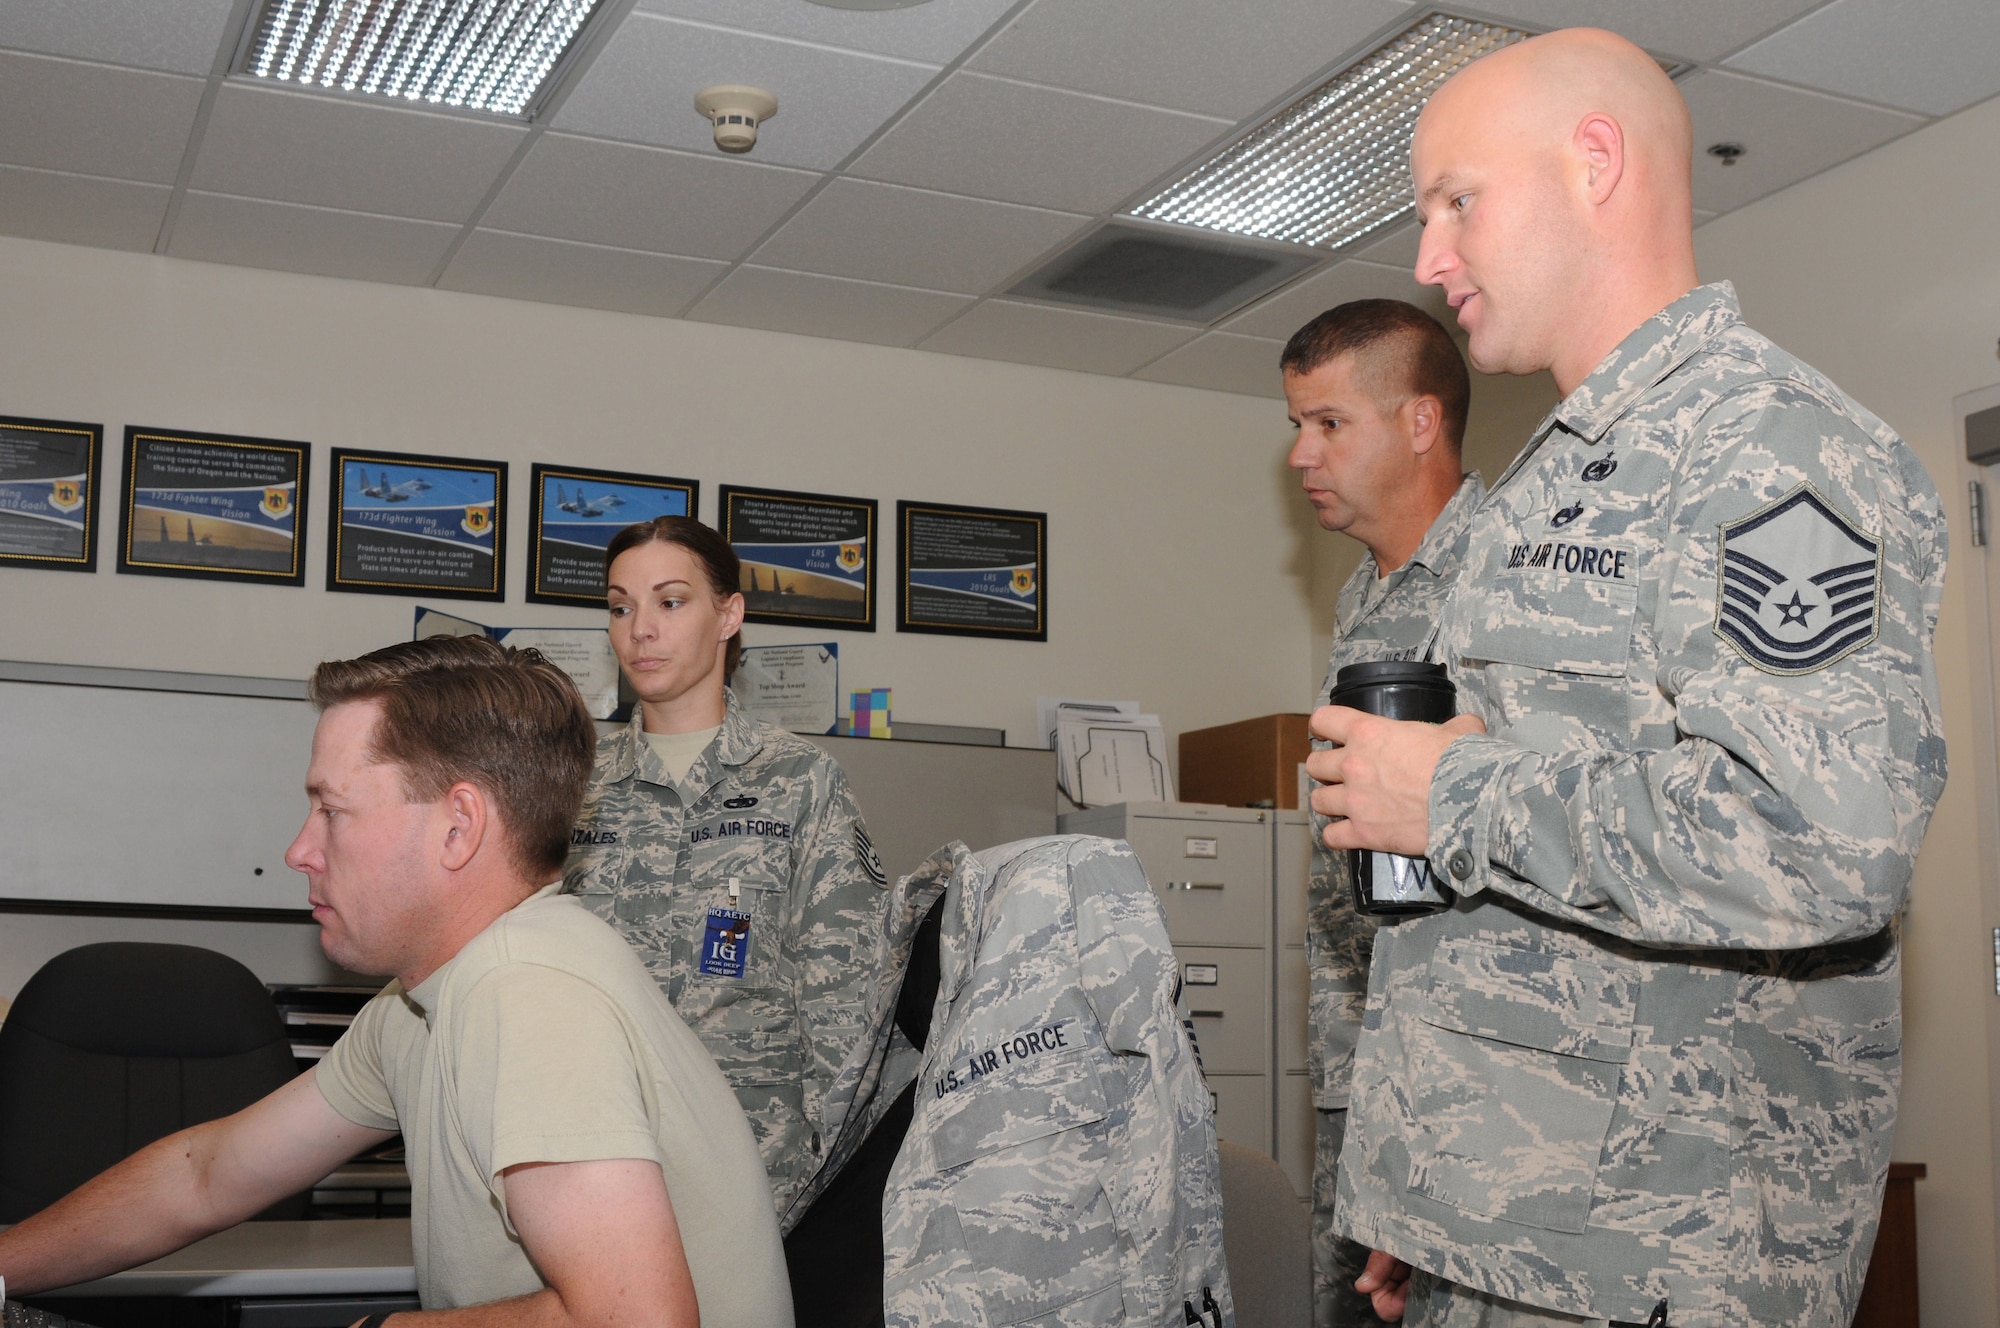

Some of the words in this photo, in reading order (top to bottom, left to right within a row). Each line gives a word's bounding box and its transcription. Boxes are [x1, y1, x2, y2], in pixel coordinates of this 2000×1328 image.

[149, 444, 174, 452] Citizen
[204, 449, 238, 460] achieving
[246, 452, 266, 461] world
[146, 454, 175, 464] training
[177, 456, 200, 465] center
[202, 458, 210, 466] to
[232, 460, 244, 468] the
[246, 462, 286, 473] community,
[153, 464, 165, 472] the
[167, 465, 185, 474] State
[188, 466, 196, 474] of
[197, 468, 222, 478] Oregon
[225, 470, 238, 478] and
[240, 471, 252, 479] the
[254, 472, 279, 481] Nation.
[0, 500, 17, 509] 010
[20, 501, 48, 510] Goals
[151, 492, 174, 501] 173d
[176, 493, 208, 505] Fighter
[210, 496, 234, 508] Wing
[221, 508, 250, 519] Vision
[744, 500, 764, 508] Ensure
[770, 502, 806, 513] professional,
[808, 506, 841, 516] dependable
[359, 512, 380, 522] 173d
[382, 513, 412, 525] Fighter
[415, 516, 438, 527] Wing
[740, 508, 766, 517] steadfast
[767, 510, 792, 520] logistics
[793, 512, 820, 521] readiness
[841, 517, 858, 525] which
[748, 518, 774, 527] supports
[802, 522, 820, 530] global
[422, 526, 456, 536] Mission
[760, 526, 780, 536] setting
[781, 528, 791, 536] the
[792, 529, 817, 538] standard
[357, 544, 385, 552] Produce
[386, 546, 398, 554] the
[400, 546, 414, 555] best
[416, 548, 447, 558] air-to-air
[448, 550, 474, 559] combat
[811, 548, 825, 558] LRS
[357, 554, 377, 562] pilots
[436, 559, 458, 568] Nation
[552, 556, 577, 566] Provide
[578, 560, 605, 568] superio
[806, 559, 830, 569] Vision
[1507, 544, 1530, 569] U.S.
[1527, 543, 1553, 568] AIR
[1553, 543, 1627, 579] FORCE
[361, 564, 379, 572] State
[390, 566, 408, 574] times
[418, 569, 438, 577] peace
[440, 569, 453, 577] and
[550, 567, 576, 576] support
[578, 570, 604, 578] ensurin
[564, 577, 597, 586] peacetime
[984, 573, 997, 582] LRS
[970, 583, 988, 592] 2010
[990, 585, 1010, 594] Goals
[771, 682, 785, 690] Shop
[691, 827, 712, 843] U.S.
[718, 821, 742, 838] AIR
[746, 820, 791, 839] FORCE
[708, 908, 722, 918] HQ
[724, 910, 750, 920] AETC
[711, 942, 736, 962] IG
[935, 1070, 965, 1100] U.S.
[969, 1050, 1000, 1080] AIR
[1001, 1024, 1068, 1065] FORCE
